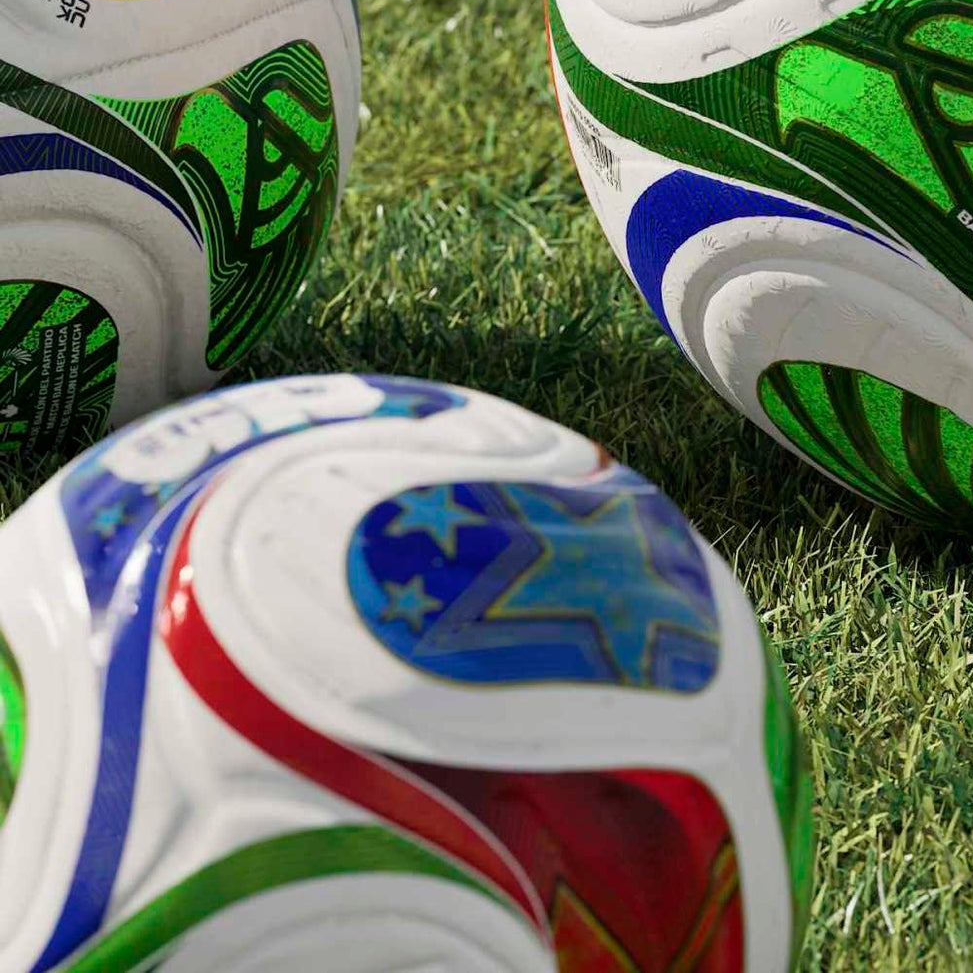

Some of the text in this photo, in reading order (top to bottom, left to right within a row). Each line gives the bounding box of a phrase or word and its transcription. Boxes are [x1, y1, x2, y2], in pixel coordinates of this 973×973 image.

[56, 4, 86, 28] UK
[42, 329, 54, 376] PARTIDO
[56, 326, 68, 372] REPLICA
[71, 323, 83, 362] MATCH
[69, 364, 79, 378] DE
[39, 376, 50, 396] DEL
[52, 372, 64, 399] BALL
